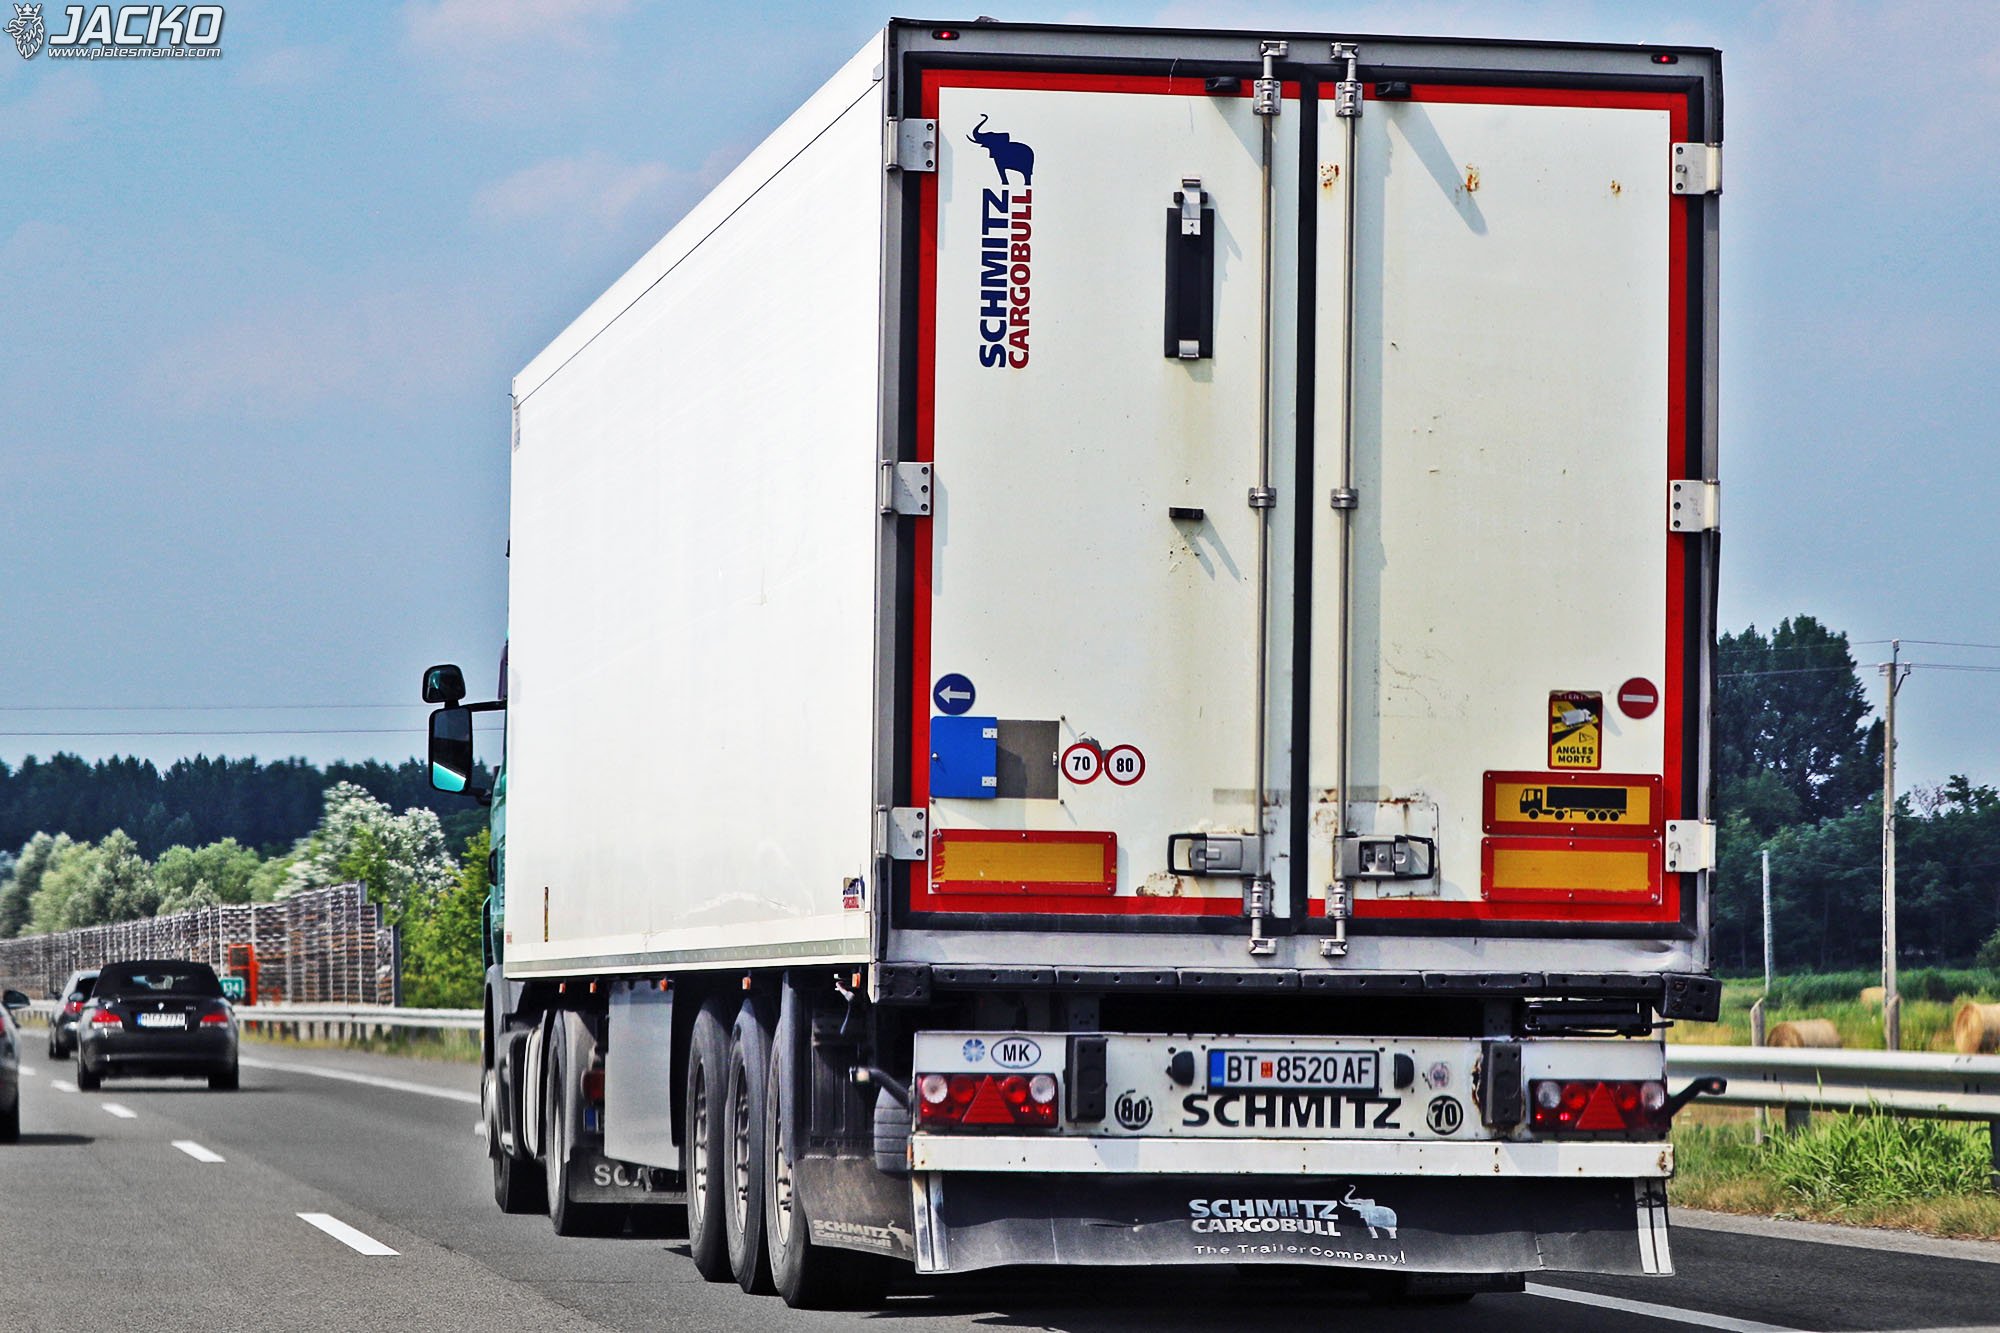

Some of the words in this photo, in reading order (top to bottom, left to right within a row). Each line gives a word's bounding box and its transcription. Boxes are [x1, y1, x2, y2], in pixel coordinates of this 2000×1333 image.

[979, 188, 1009, 368] SCHMITZ
[1008, 188, 1032, 369] CARGOBULL
[1556, 747, 1594, 755] ANGLES
[1558, 755, 1592, 764] MORTS
[1073, 756, 1090, 771] 70
[1116, 758, 1133, 773] 80
[1003, 1044, 1030, 1062] MK
[1227, 1056, 1257, 1083] BT
[1276, 1056, 1338, 1083] 8520
[1343, 1057, 1372, 1084] AF
[1120, 1099, 1147, 1123] 80
[1182, 1094, 1402, 1129] SCHMITZ
[1431, 1103, 1458, 1128] 70
[1188, 1199, 1339, 1219] SCHMITZ
[813, 1219, 891, 1239] SCHMITZ
[1191, 1218, 1341, 1237] CARGOBULL
[814, 1230, 892, 1248] Cargobull
[1194, 1245, 1230, 1255] The
